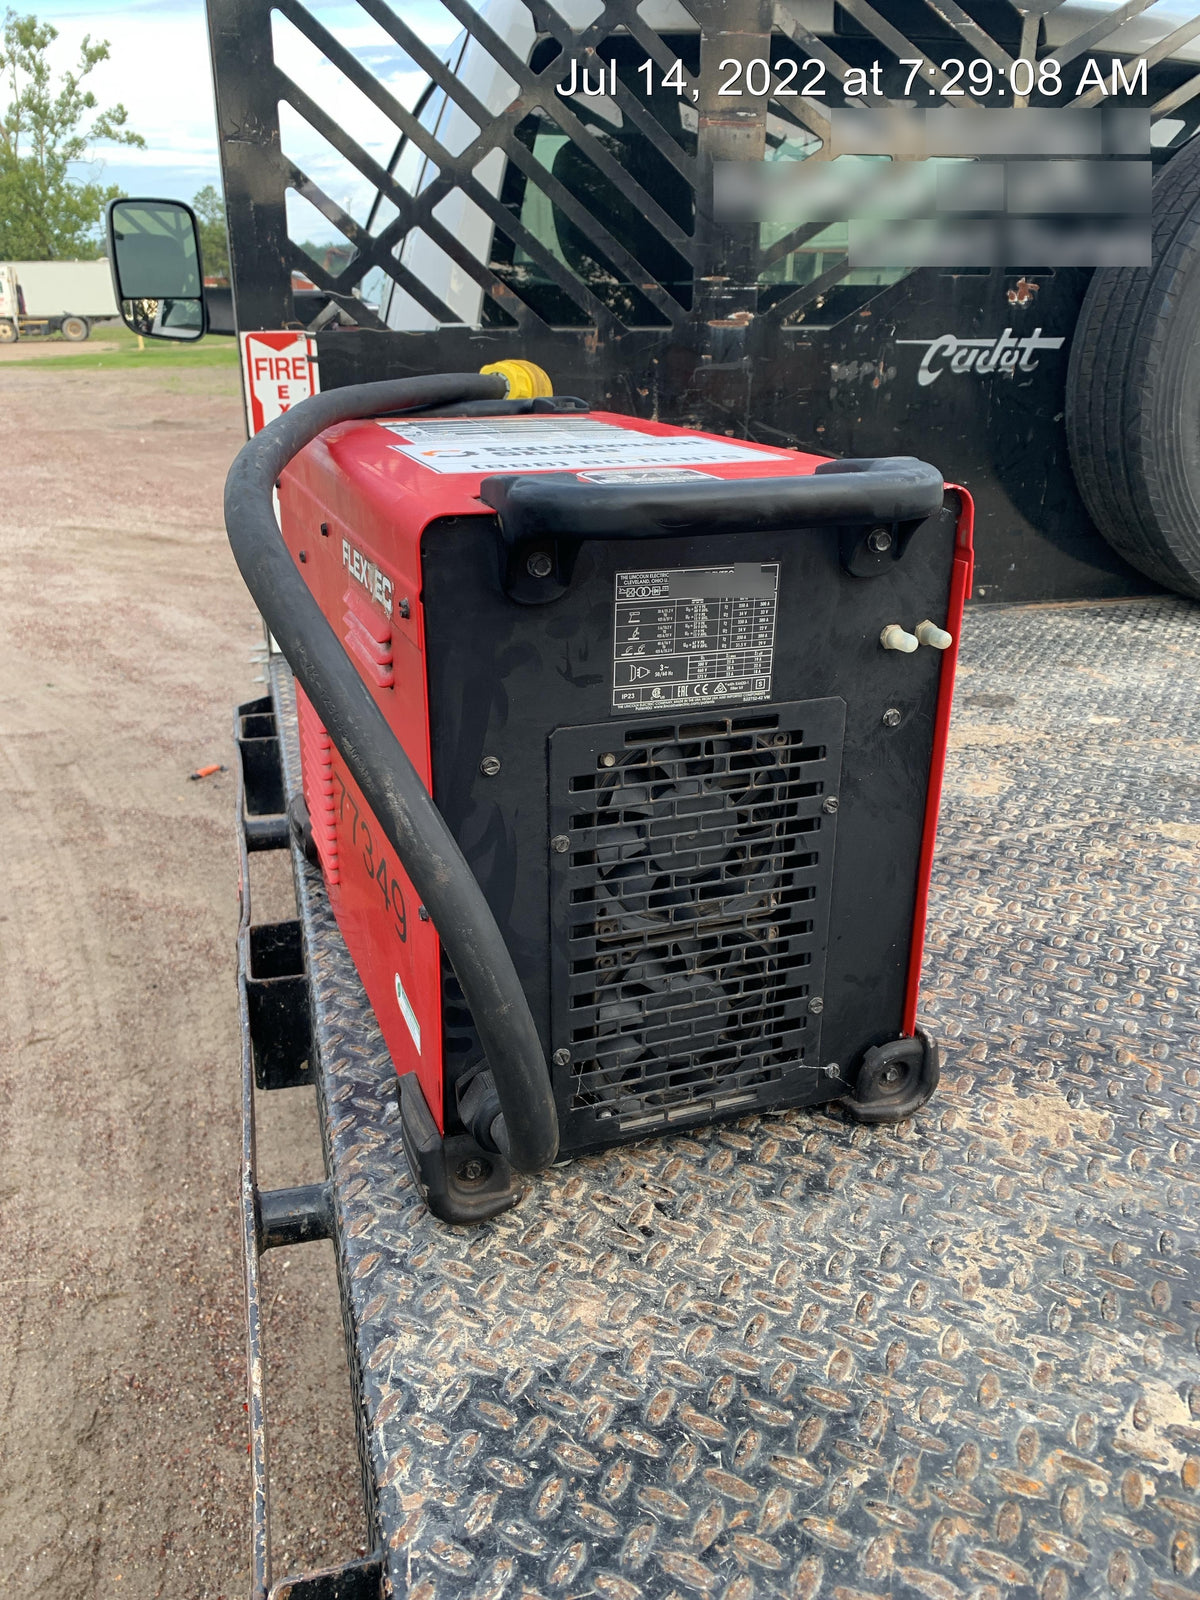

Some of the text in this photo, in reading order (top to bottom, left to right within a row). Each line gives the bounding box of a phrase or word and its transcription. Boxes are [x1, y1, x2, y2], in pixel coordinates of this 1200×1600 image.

[254, 356, 307, 381] FIRE
[621, 692, 635, 700] IP23
[334, 770, 408, 944] 77349
